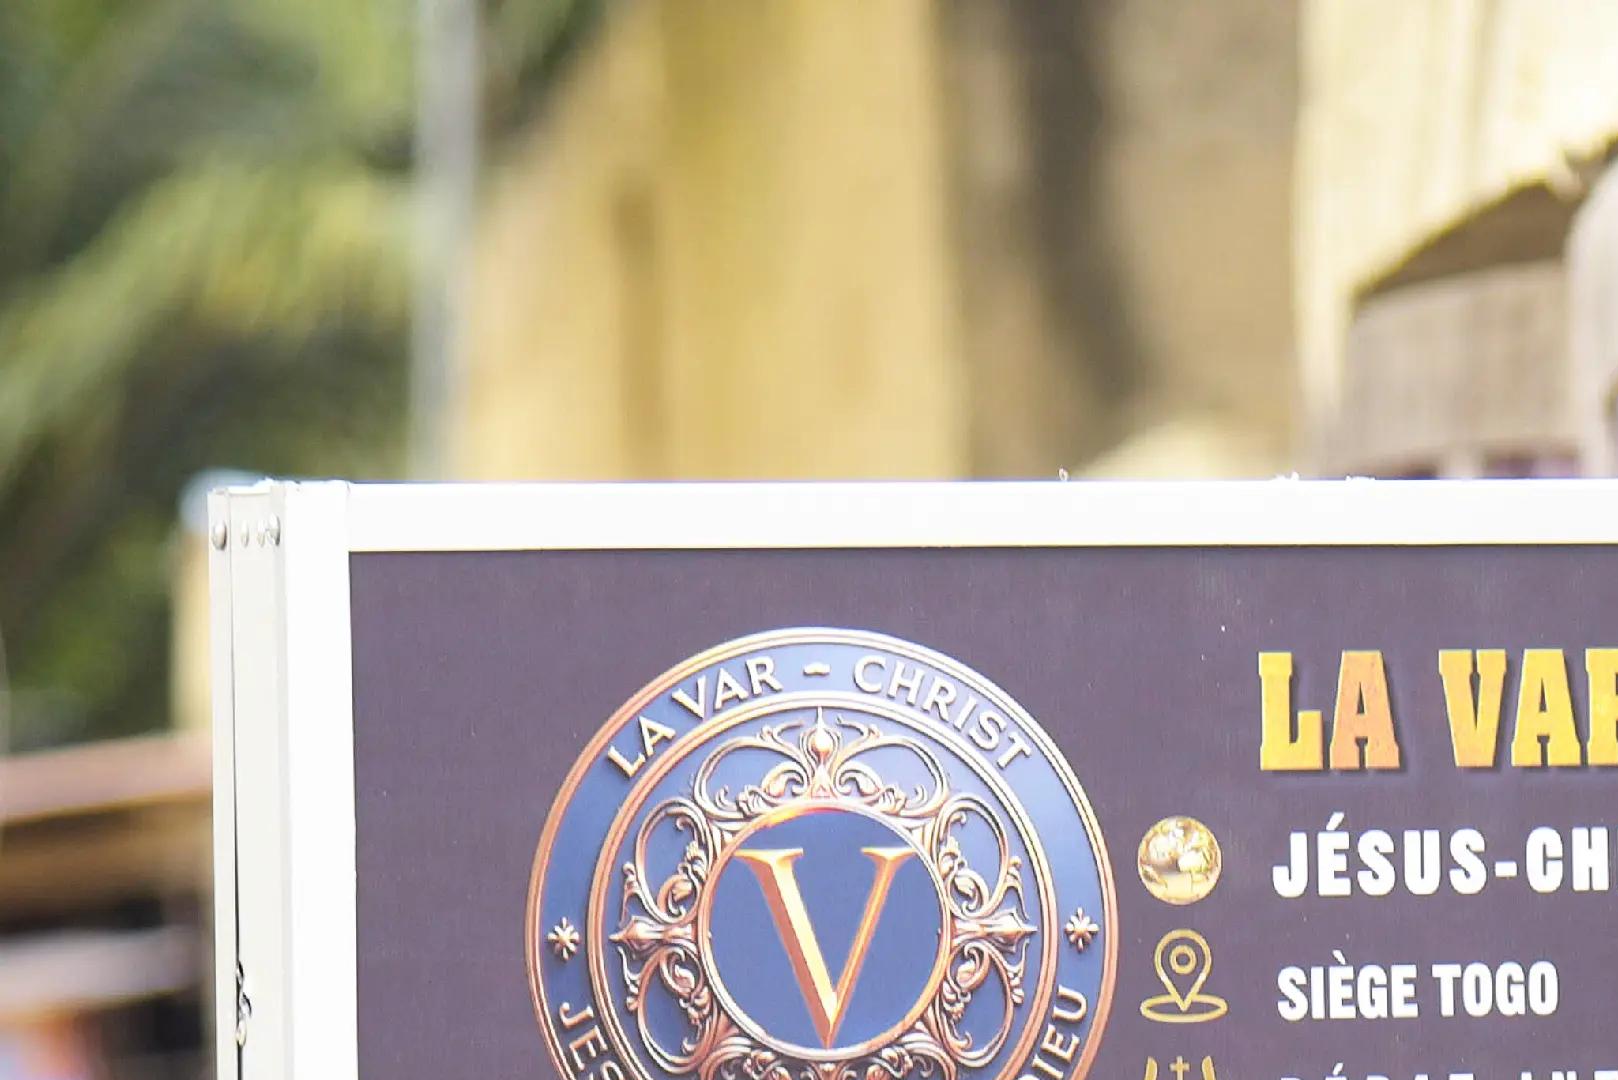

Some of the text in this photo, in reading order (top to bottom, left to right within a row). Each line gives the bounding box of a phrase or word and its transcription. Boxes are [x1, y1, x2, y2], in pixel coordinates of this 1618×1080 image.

[604, 713, 677, 779] LA
[671, 655, 783, 718] VAR
[854, 655, 1034, 773] CHRIST
[1257, 650, 1400, 771] LA
[732, 846, 916, 1049] V
[1277, 953, 1559, 1021] SIÈGE TOGO
